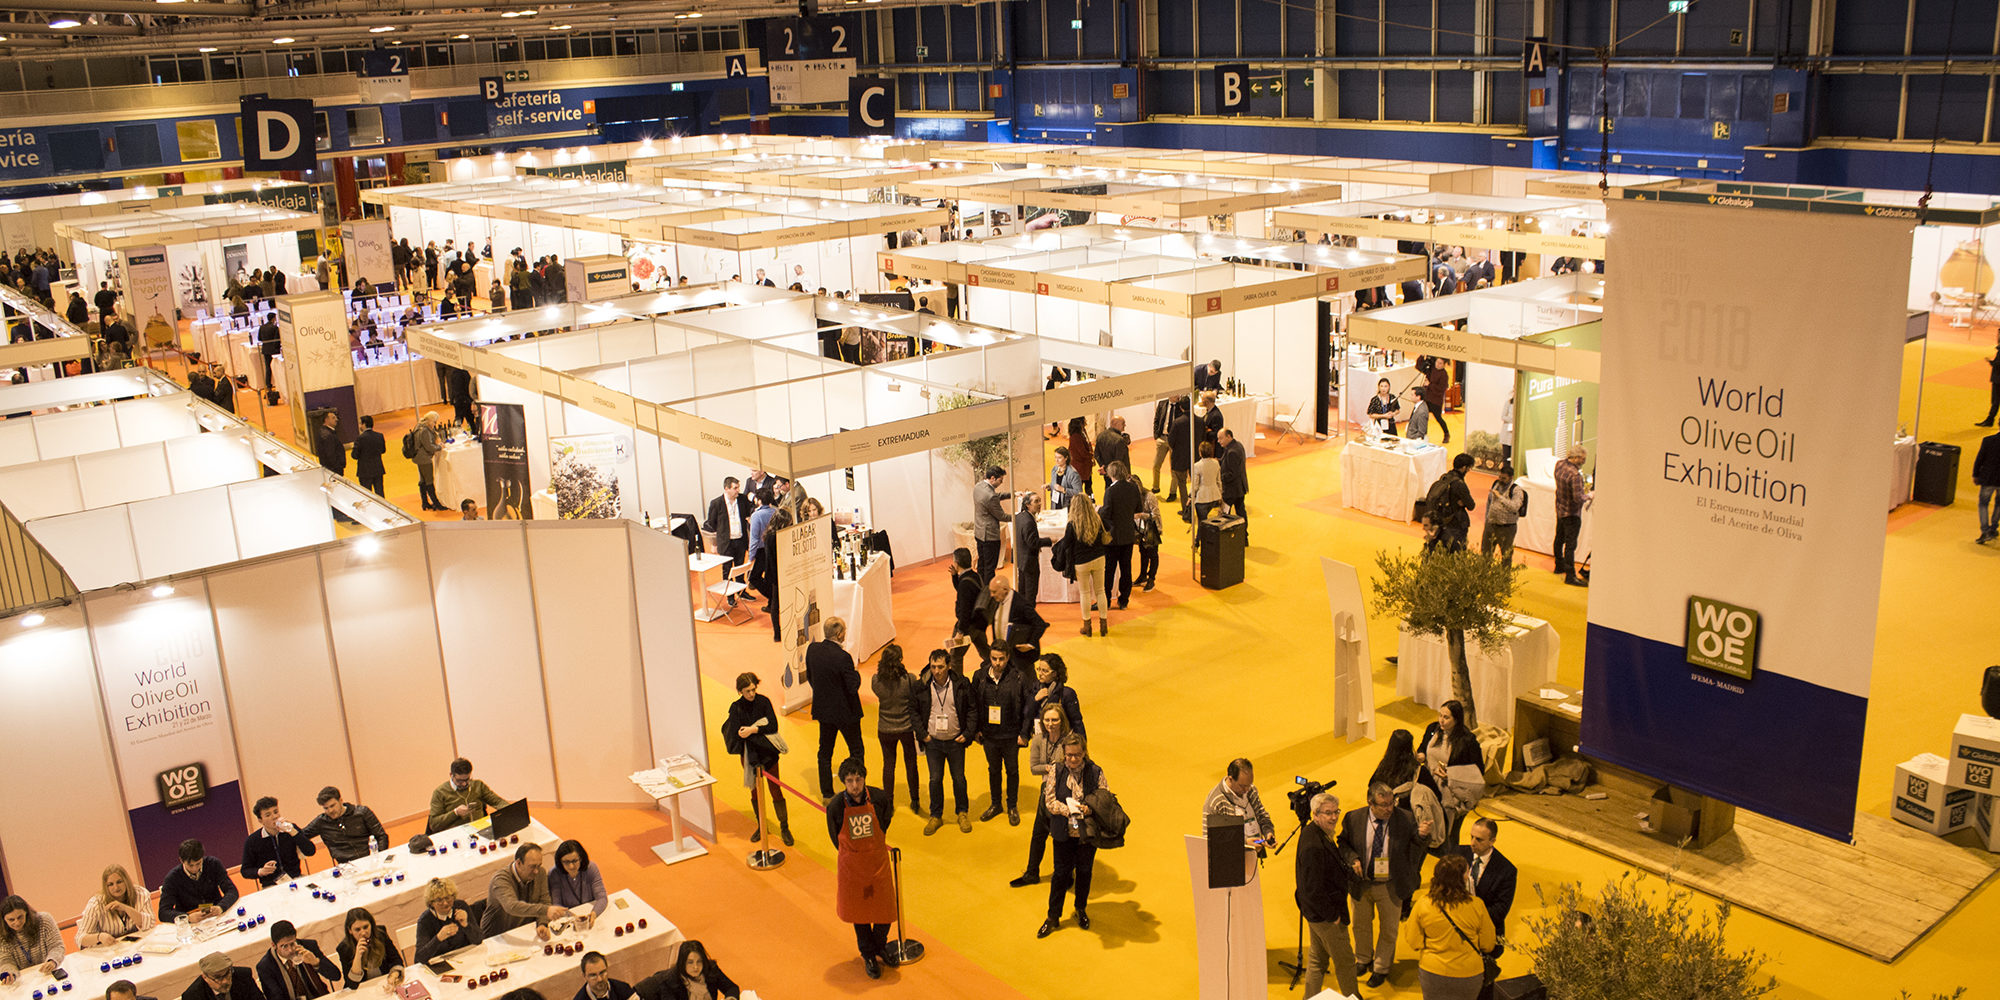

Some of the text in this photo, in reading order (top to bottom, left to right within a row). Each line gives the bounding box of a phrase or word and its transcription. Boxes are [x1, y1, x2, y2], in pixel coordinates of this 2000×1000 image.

[831, 25, 847, 52] 2
[390, 56, 402, 73] 2
[730, 58, 744, 76] A
[1530, 43, 1543, 72] A
[485, 80, 498, 99] B
[1224, 72, 1241, 106] B
[859, 86, 885, 127] C
[496, 107, 582, 126] self-service
[257, 110, 301, 161] D
[1717, 196, 1754, 208] Globalcaja
[1875, 207, 1917, 219] Globalcaja
[141, 283, 168, 294] valor
[299, 326, 337, 342] Olive Oil
[1404, 329, 1428, 338] AEGEAN
[1428, 332, 1446, 341] OLIVE
[1387, 335, 1467, 354] OLIVE OIL EXPORTERS ASSOC
[1529, 376, 1554, 396] Pura
[1080, 389, 1124, 404] EXTREMADURA
[1698, 376, 1784, 417] World
[700, 431, 732, 448] EXTREMADURA
[877, 429, 930, 447] EXTREMADURA
[1664, 452, 1807, 506] Exhibition
[1696, 496, 1804, 528] El Encuentro Mundial
[1710, 513, 1803, 542] del Aceite de Oliva
[792, 535, 817, 557] DEL SOTO
[1694, 601, 1753, 639] WO
[1697, 630, 1745, 666] OE
[134, 661, 187, 687] World
[1724, 663, 1748, 675] Exhibition
[1716, 681, 1745, 694] MADRID
[125, 699, 211, 732] Exhibition
[162, 766, 199, 787] WO
[1968, 764, 1991, 777] WO
[1969, 773, 1988, 785] OE
[169, 780, 199, 799] OE
[1909, 775, 1927, 790] WO
[1910, 785, 1926, 799] OE
[849, 815, 872, 827] WO
[853, 824, 871, 836] OE
